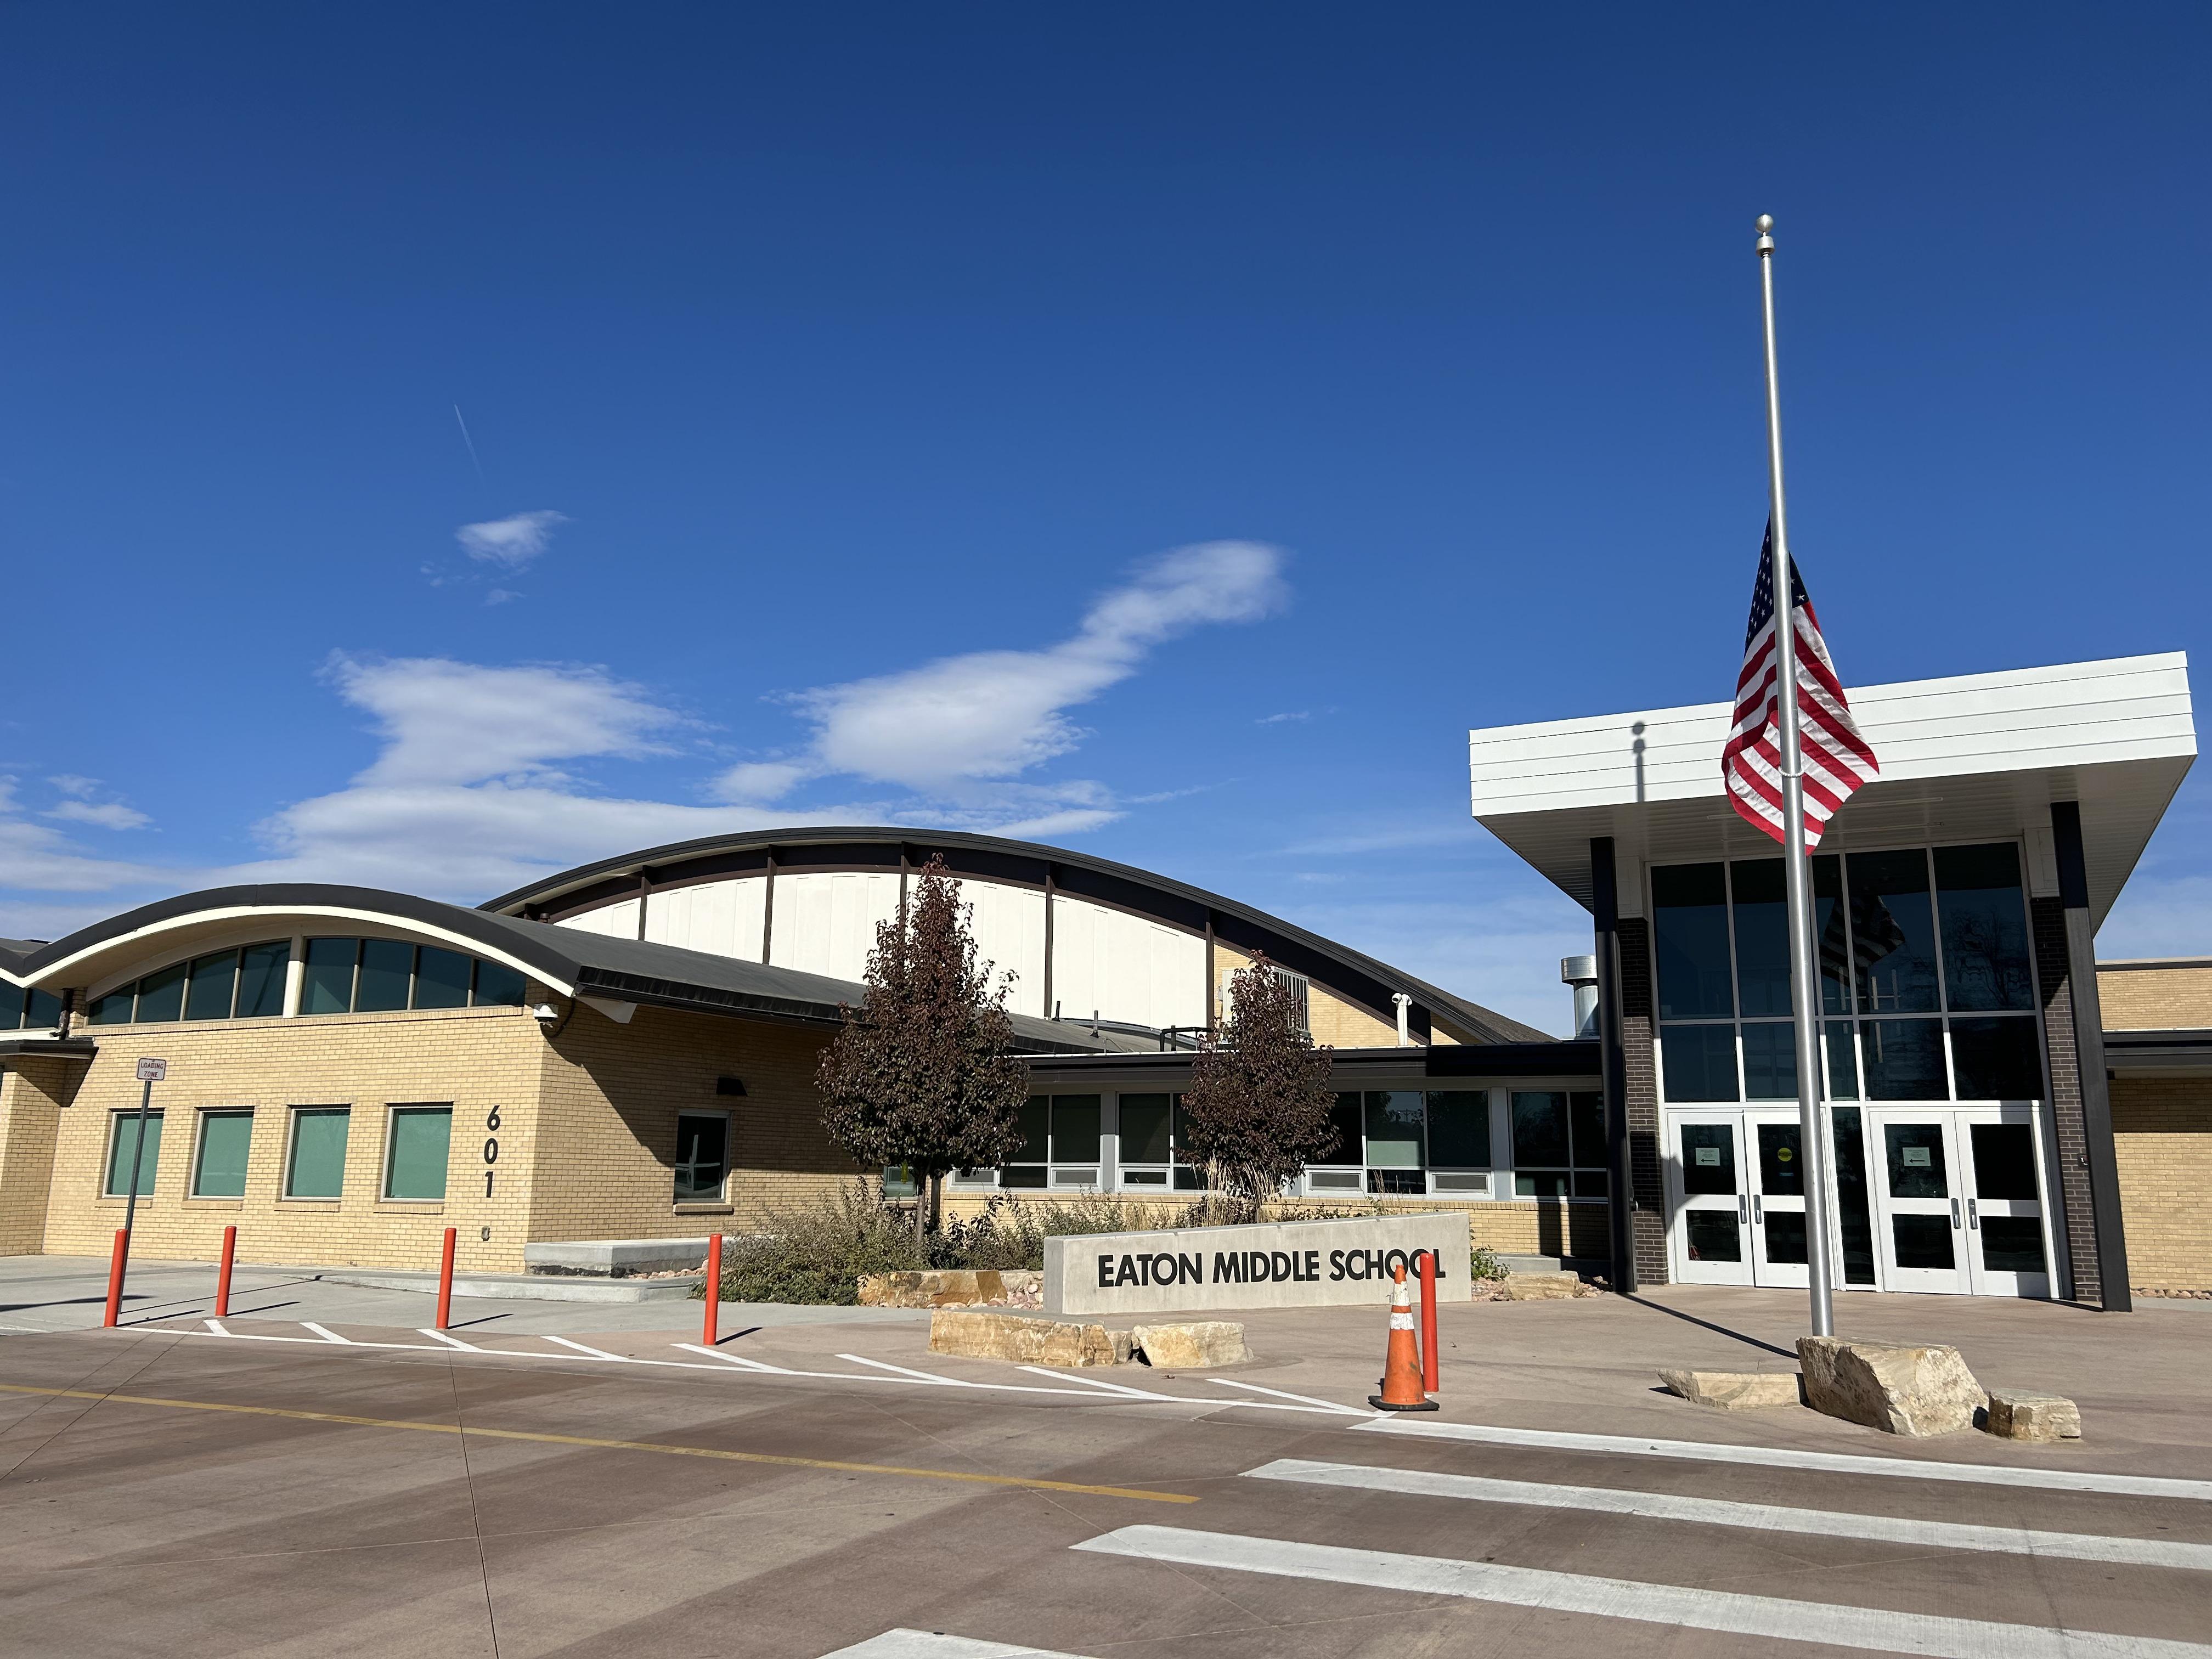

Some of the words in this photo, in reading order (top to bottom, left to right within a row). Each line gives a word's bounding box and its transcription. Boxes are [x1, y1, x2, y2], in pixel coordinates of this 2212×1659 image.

[484, 1105, 500, 1198] 601
[1098, 1253, 1202, 1287] EATON
[1212, 1250, 1319, 1283] MIDDLE
